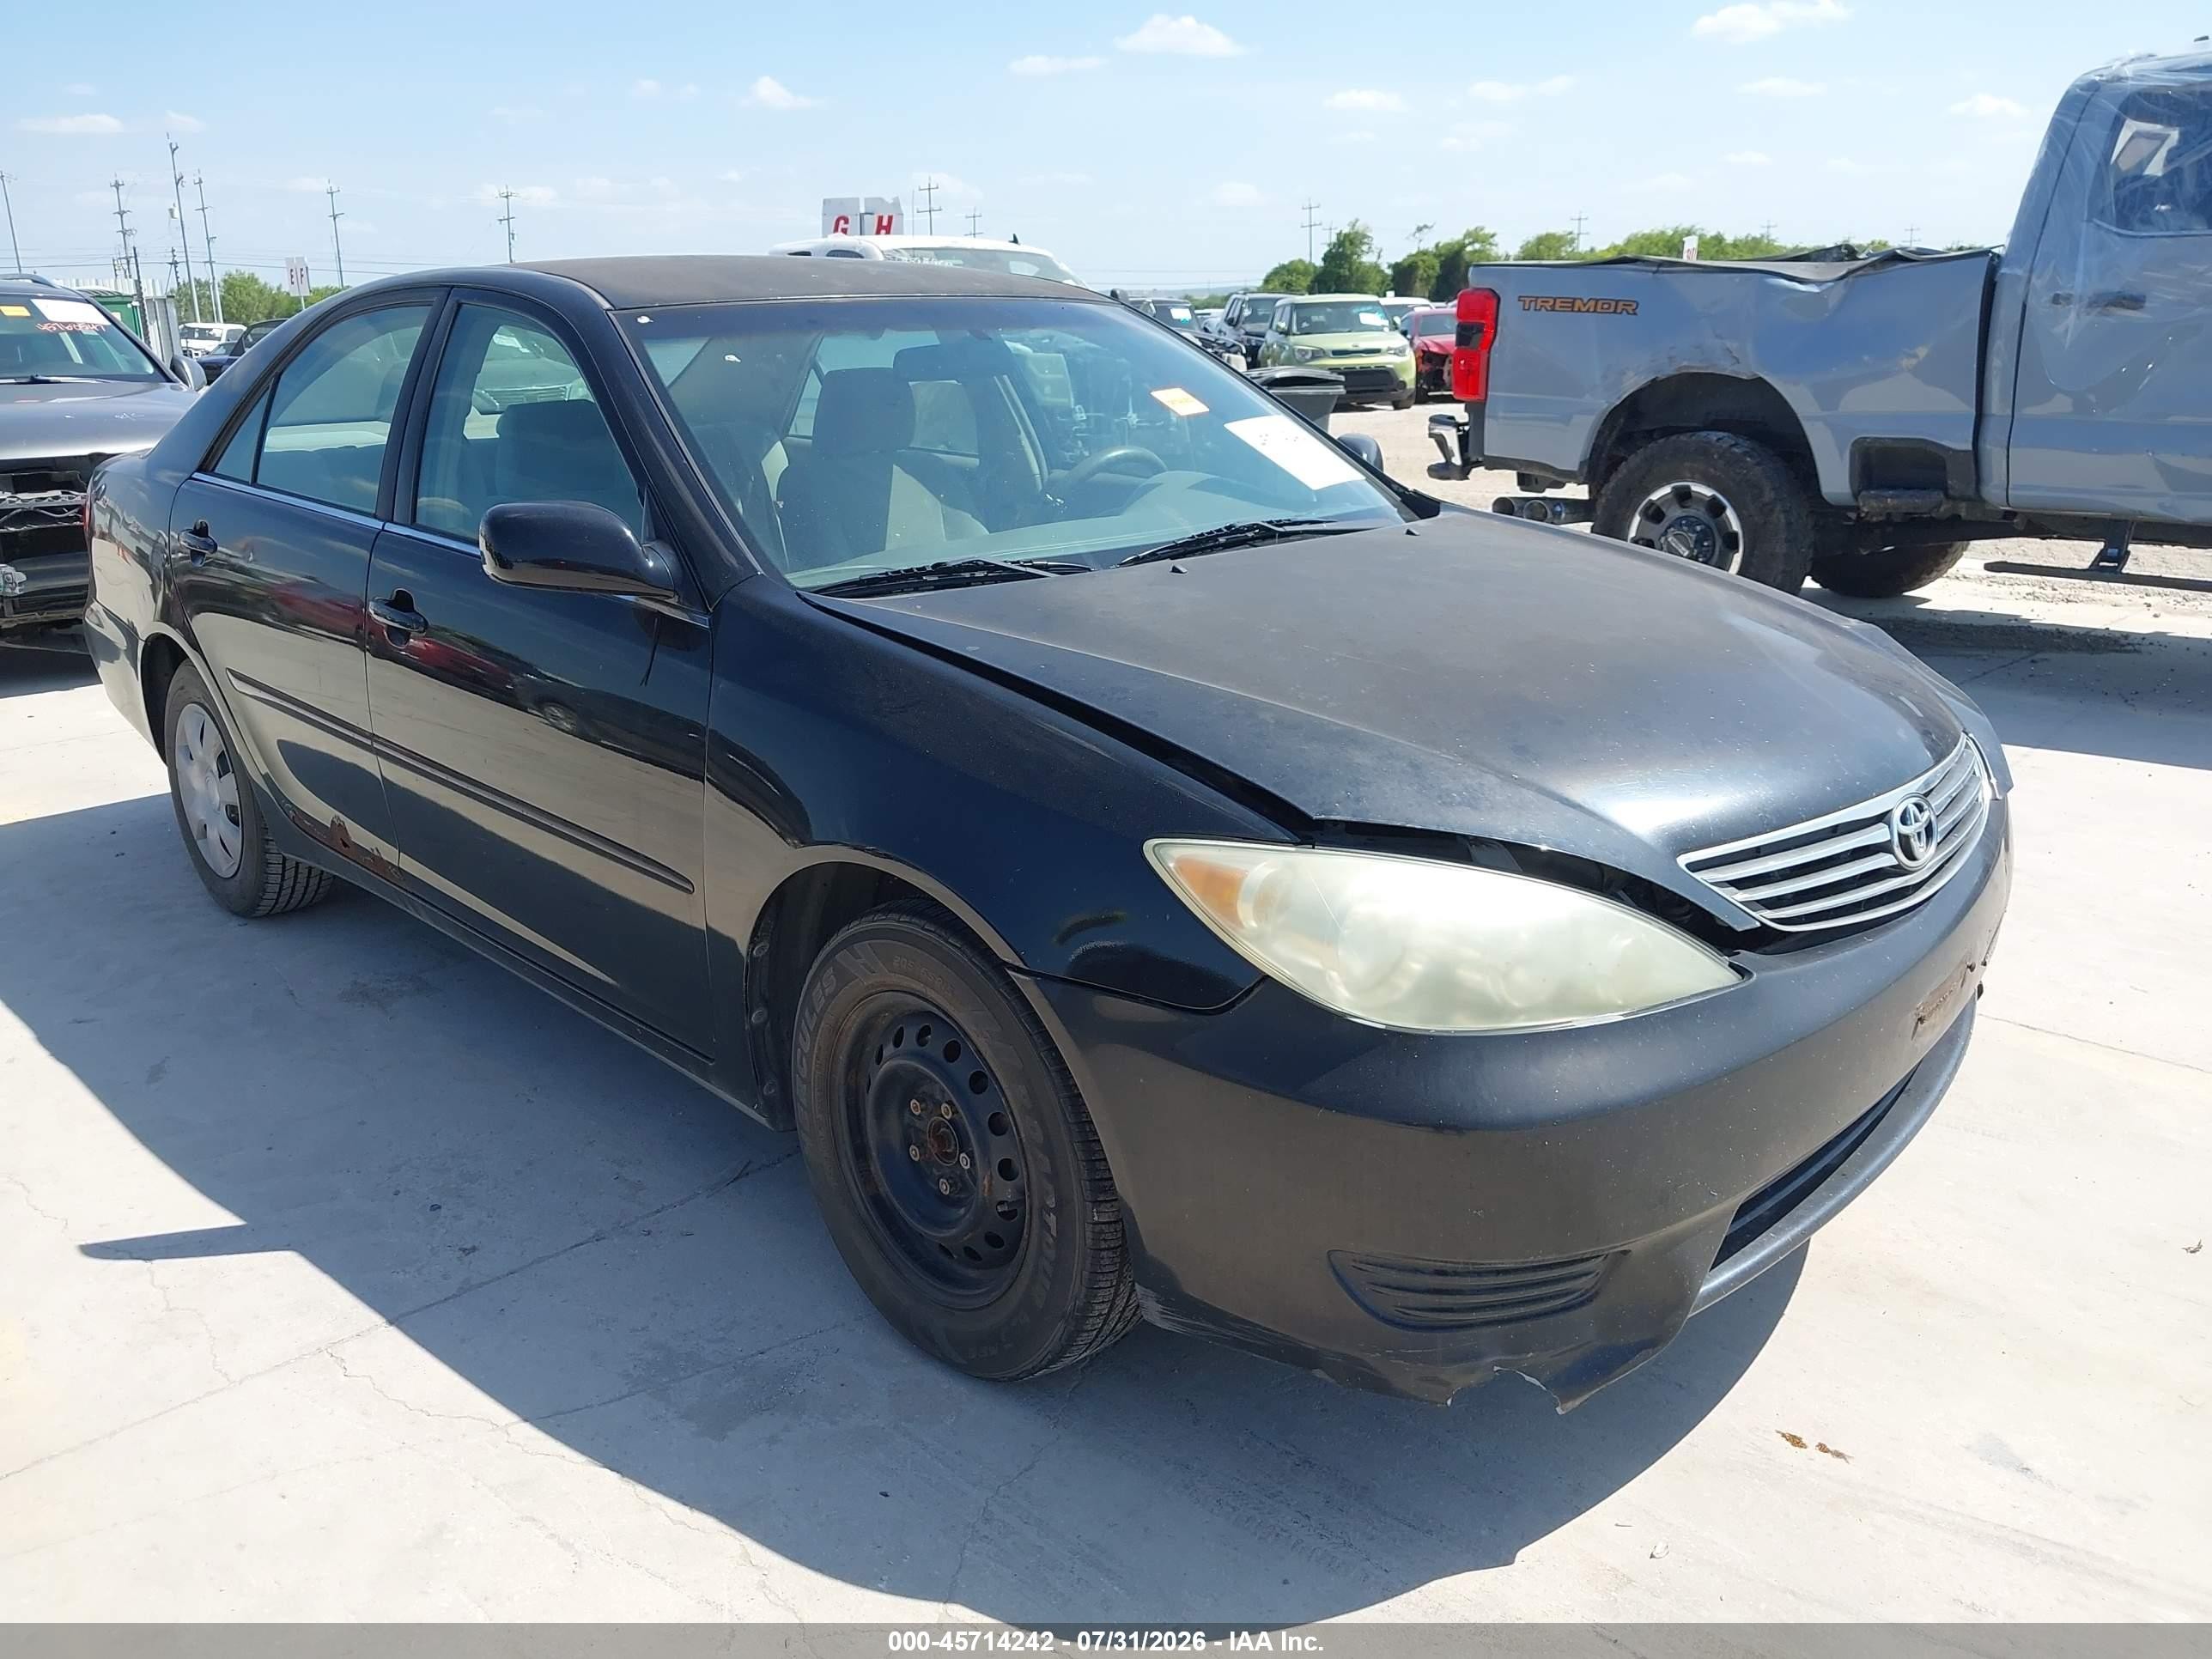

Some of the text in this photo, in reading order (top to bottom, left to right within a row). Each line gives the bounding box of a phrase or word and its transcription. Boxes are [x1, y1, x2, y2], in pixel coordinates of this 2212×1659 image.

[833, 215, 894, 234] G H
[290, 267, 304, 285] E F
[1518, 295, 1639, 316] TREMOR
